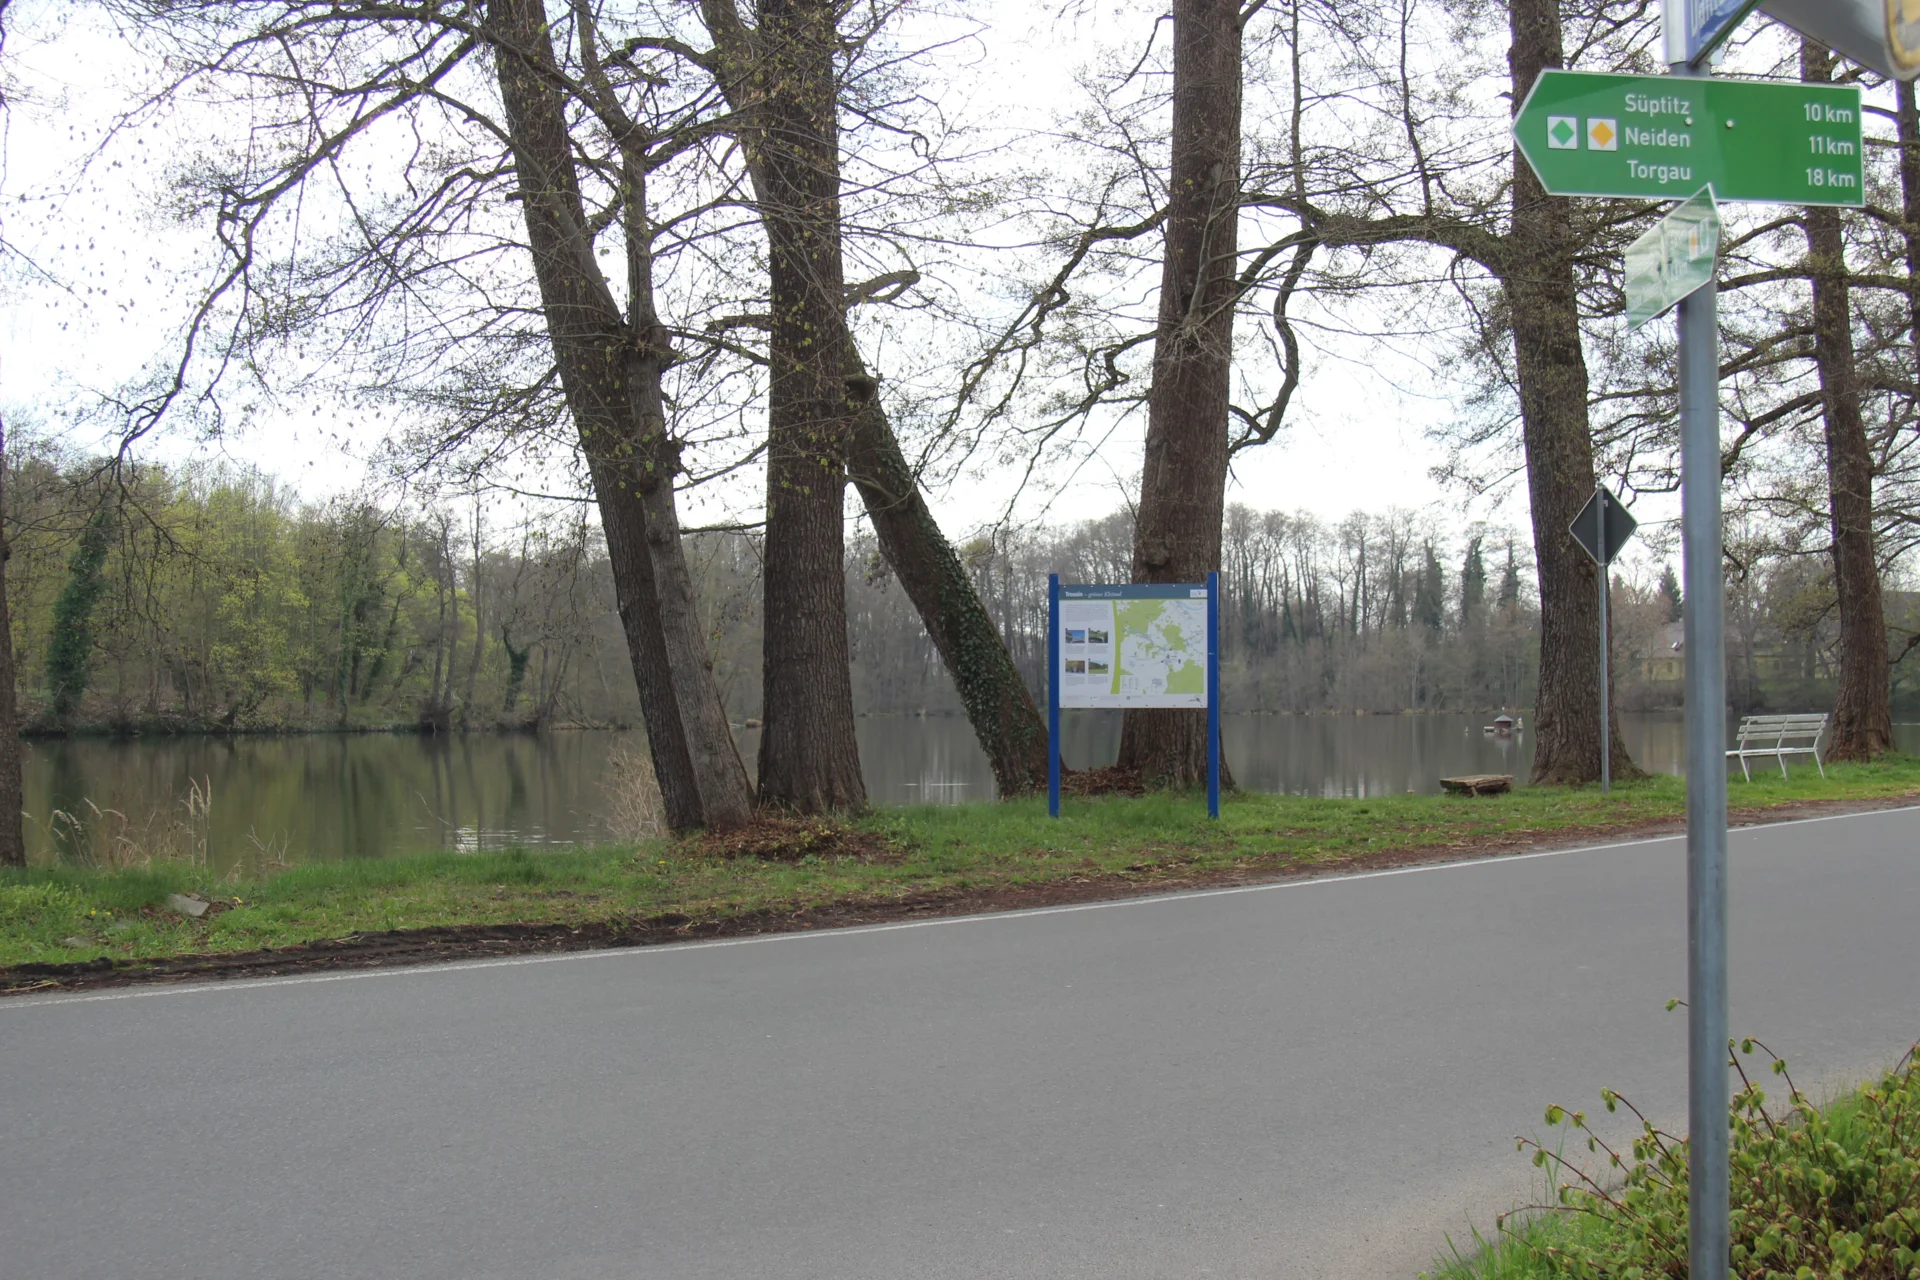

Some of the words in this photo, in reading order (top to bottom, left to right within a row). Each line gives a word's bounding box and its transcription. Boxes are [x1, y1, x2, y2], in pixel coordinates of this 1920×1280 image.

[1624, 93, 1691, 117] Süptitz
[1803, 103, 1822, 122] 10
[1825, 105, 1853, 123] km
[1625, 126, 1691, 148] Neiden
[1809, 135, 1826, 154] 11
[1827, 137, 1854, 156] km
[1626, 159, 1692, 185] Torgau
[1806, 168, 1824, 187] 18
[1827, 169, 1855, 188] km
